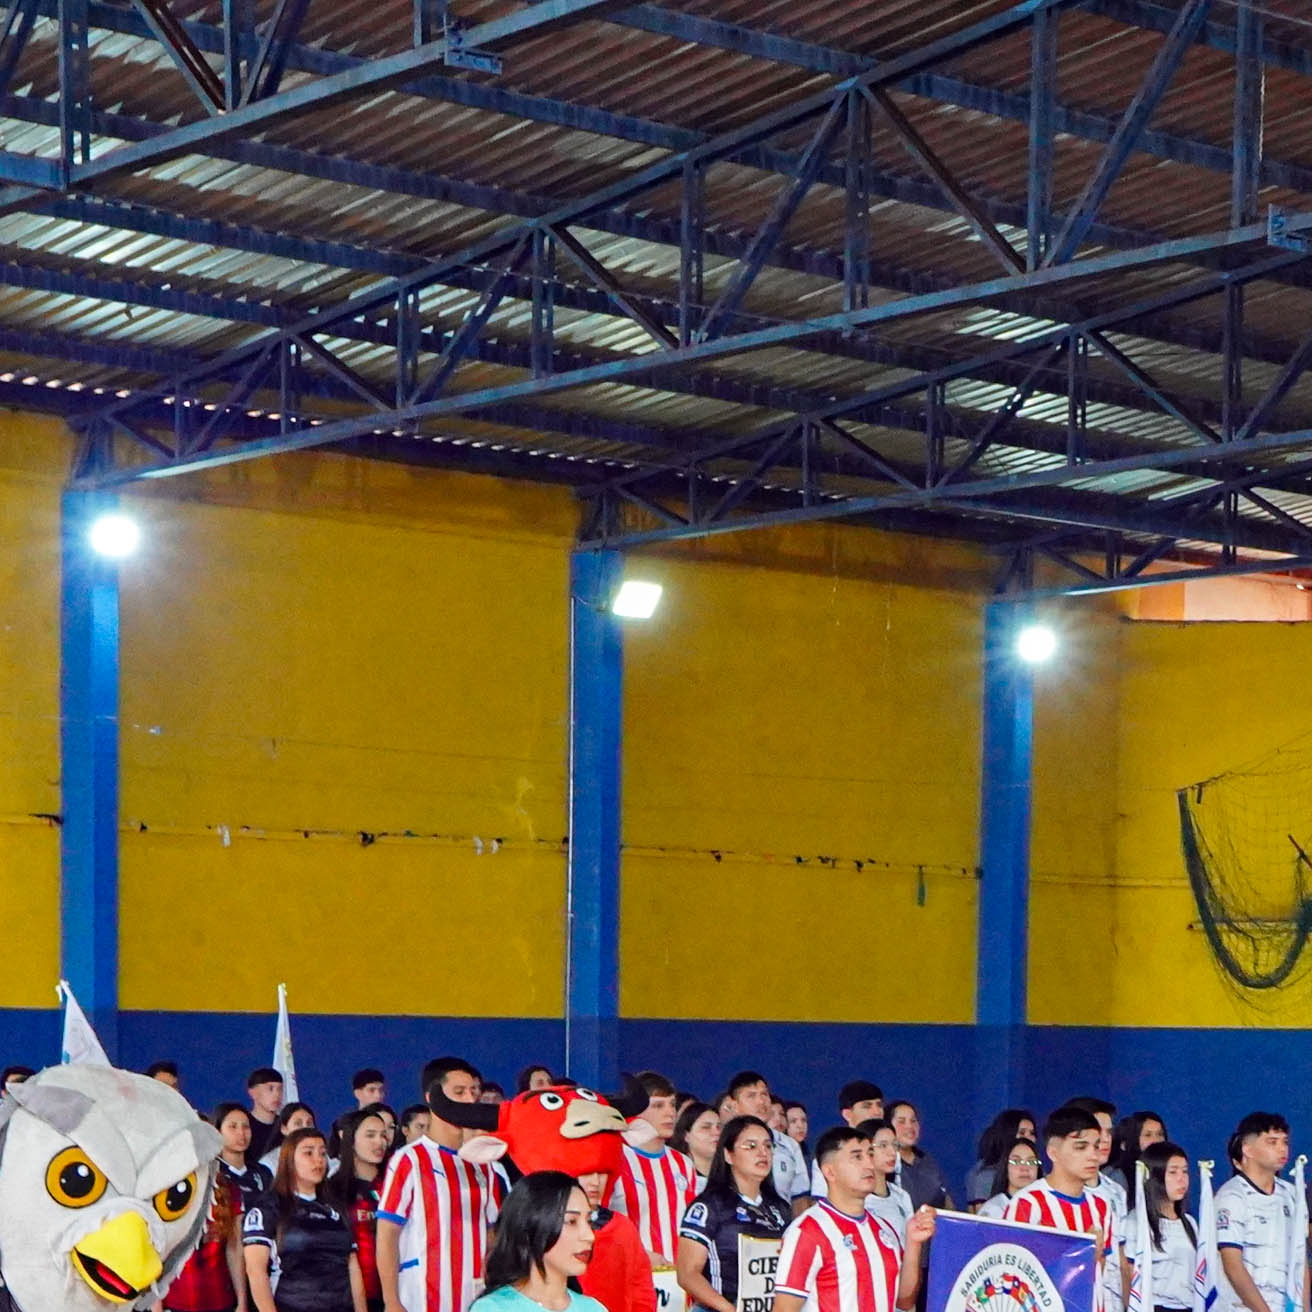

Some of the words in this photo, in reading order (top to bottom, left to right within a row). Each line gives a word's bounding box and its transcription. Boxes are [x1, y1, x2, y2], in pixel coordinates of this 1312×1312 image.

[748, 1256, 779, 1275] CIE
[1004, 1254, 1017, 1266] ES
[1017, 1259, 1052, 1307] LIBERTAD
